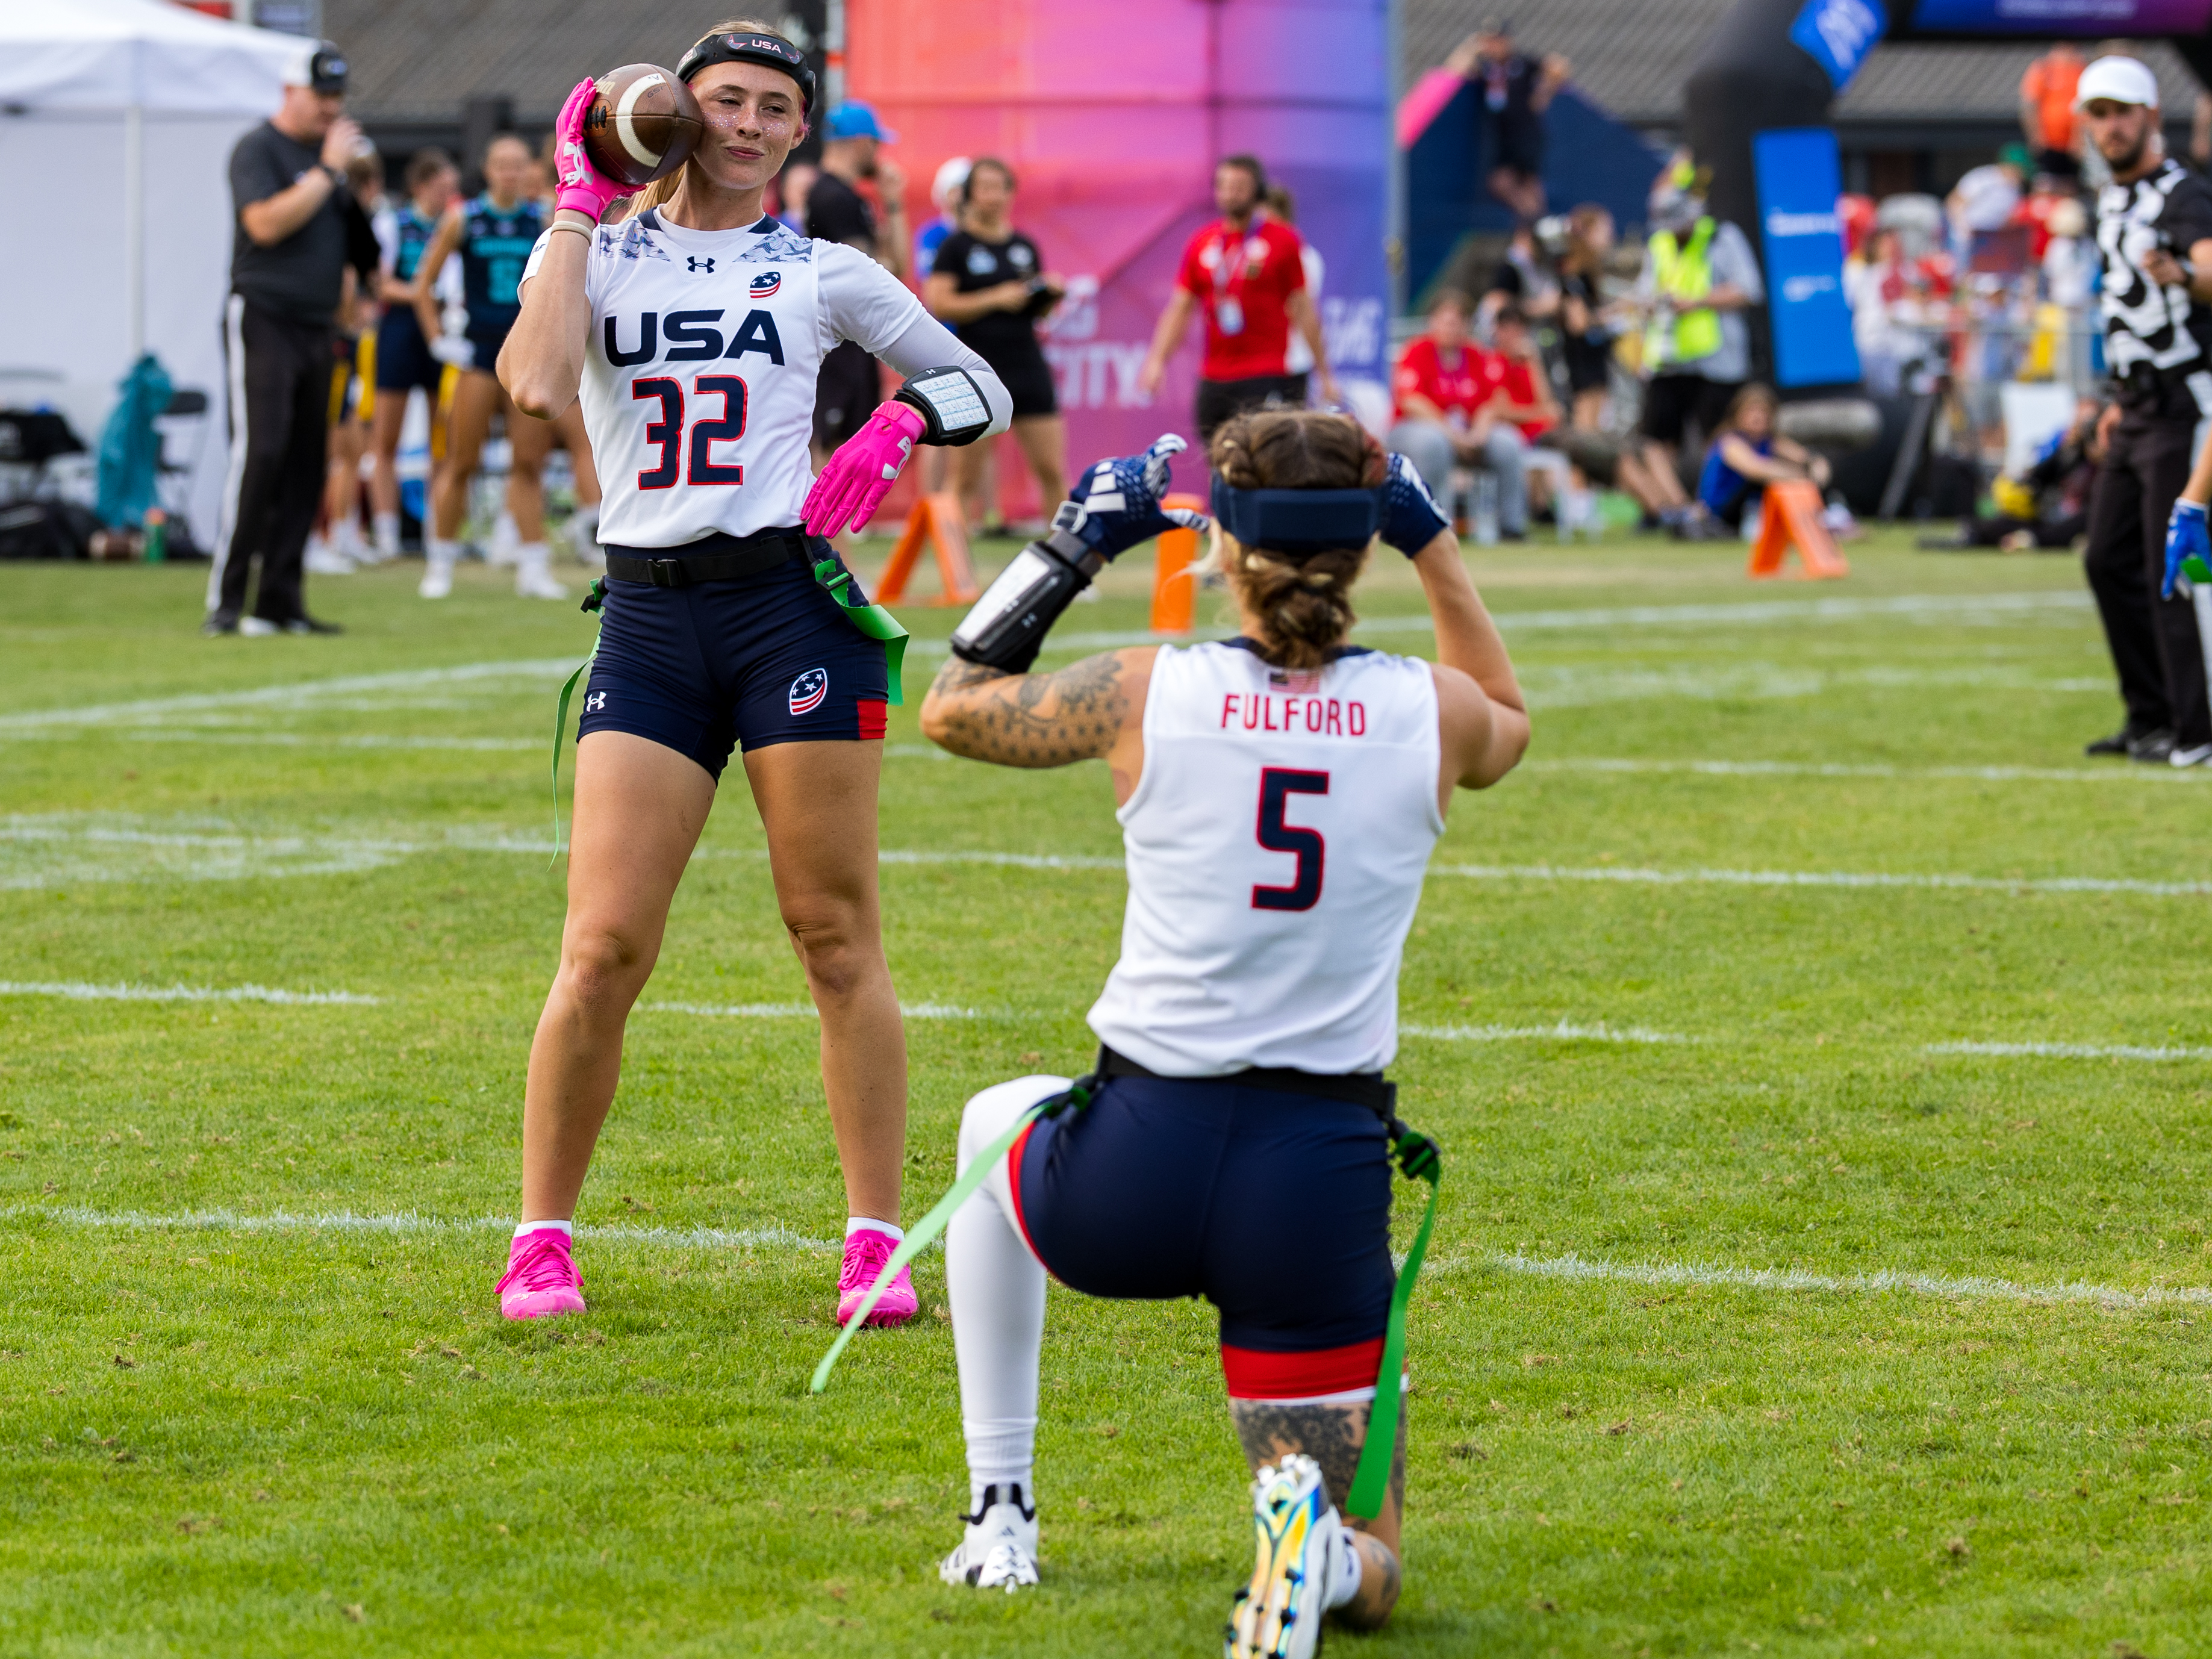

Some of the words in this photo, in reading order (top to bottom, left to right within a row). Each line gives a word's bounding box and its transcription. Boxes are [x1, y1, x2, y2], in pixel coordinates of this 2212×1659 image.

[680, 49, 694, 67] 32
[752, 39, 782, 54] USA
[604, 309, 785, 367] USA
[632, 375, 748, 490] 32
[1221, 694, 1365, 736] FULFORD
[1251, 765, 1330, 911] 5
